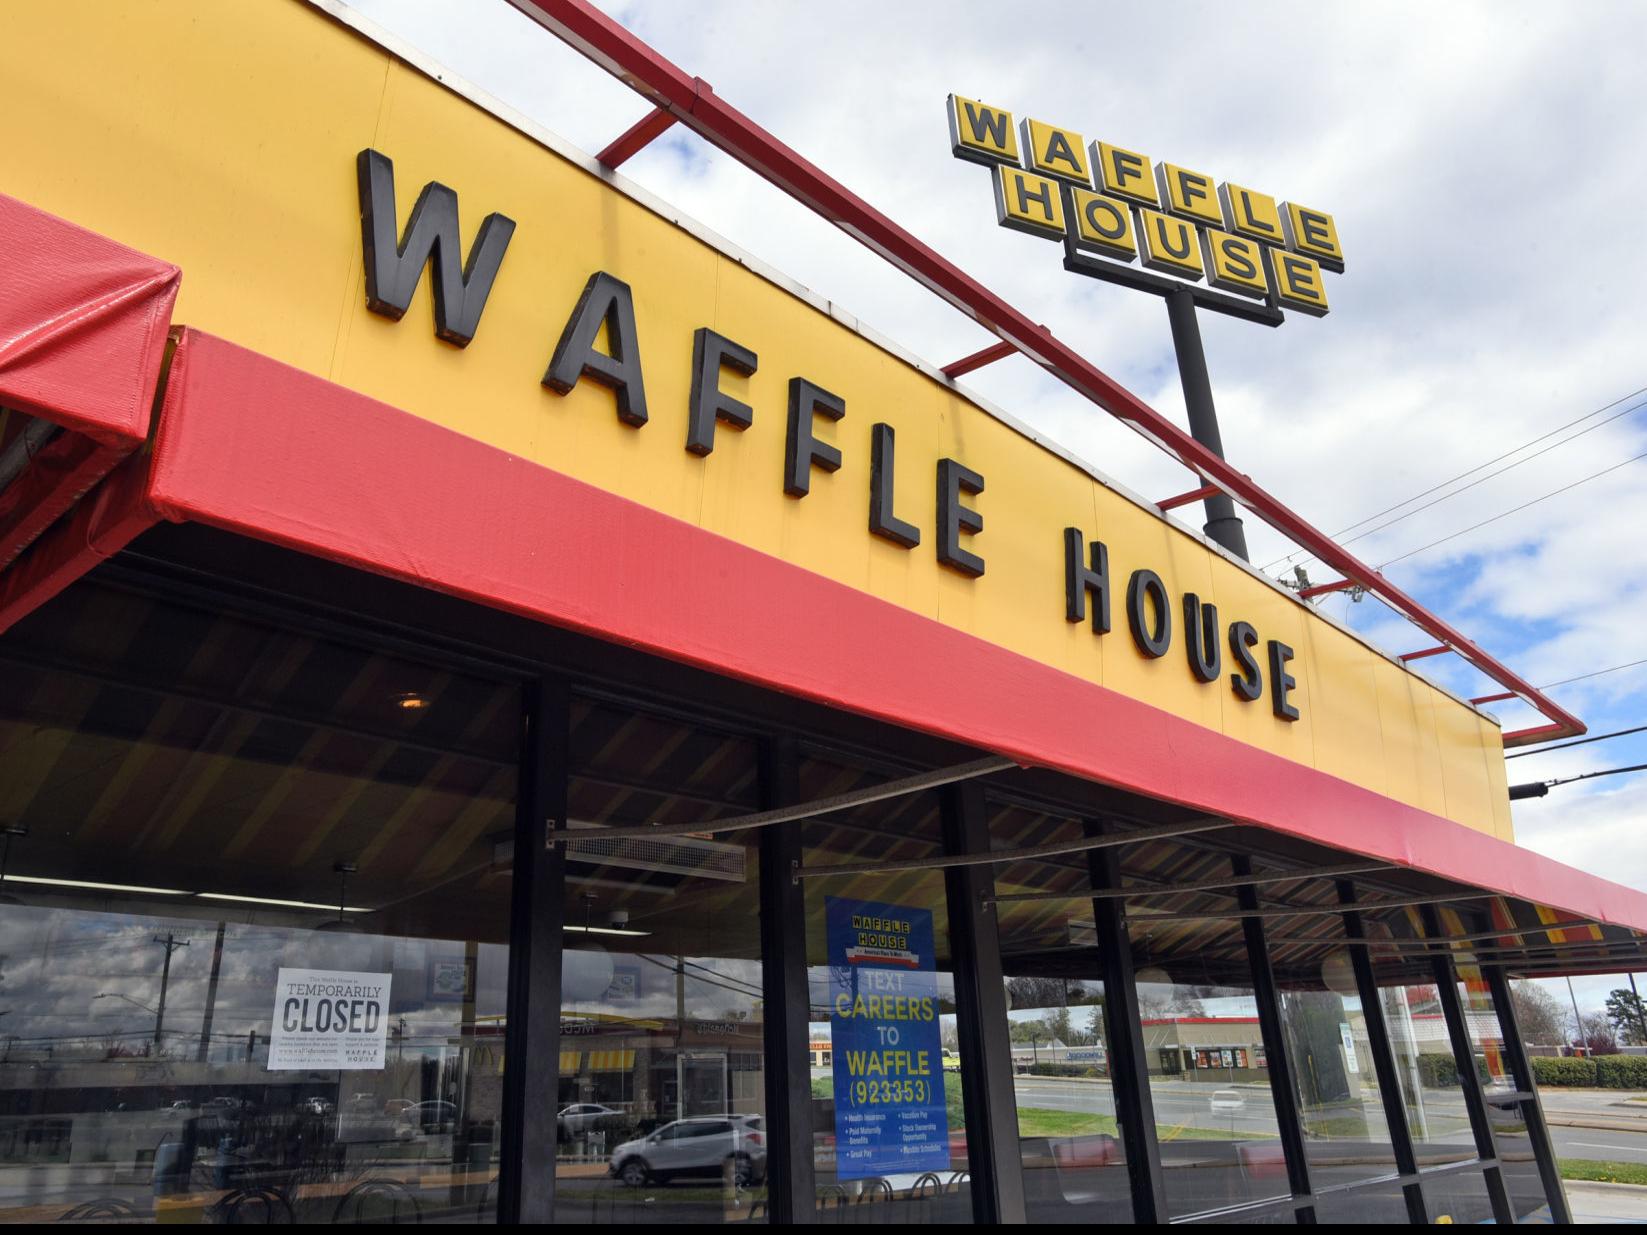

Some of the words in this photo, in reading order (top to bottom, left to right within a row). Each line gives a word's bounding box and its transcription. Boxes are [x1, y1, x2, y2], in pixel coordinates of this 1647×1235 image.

[964, 102, 1334, 251] WAFFLE
[1014, 174, 1320, 299] HOUSE
[356, 147, 985, 579] WAFFLE
[1063, 526, 1300, 723] HOUSE
[852, 916, 910, 933] WAFFLE
[859, 933, 906, 949] HOUSE
[287, 983, 382, 998] TEMPORARILY
[864, 970, 905, 991] TEXT
[282, 998, 380, 1033] CLOSED
[836, 993, 934, 1022] CAREERS
[877, 1026, 899, 1046] TO
[846, 1050, 931, 1076] WAFFLE
[850, 1079, 931, 1107] (923353)
